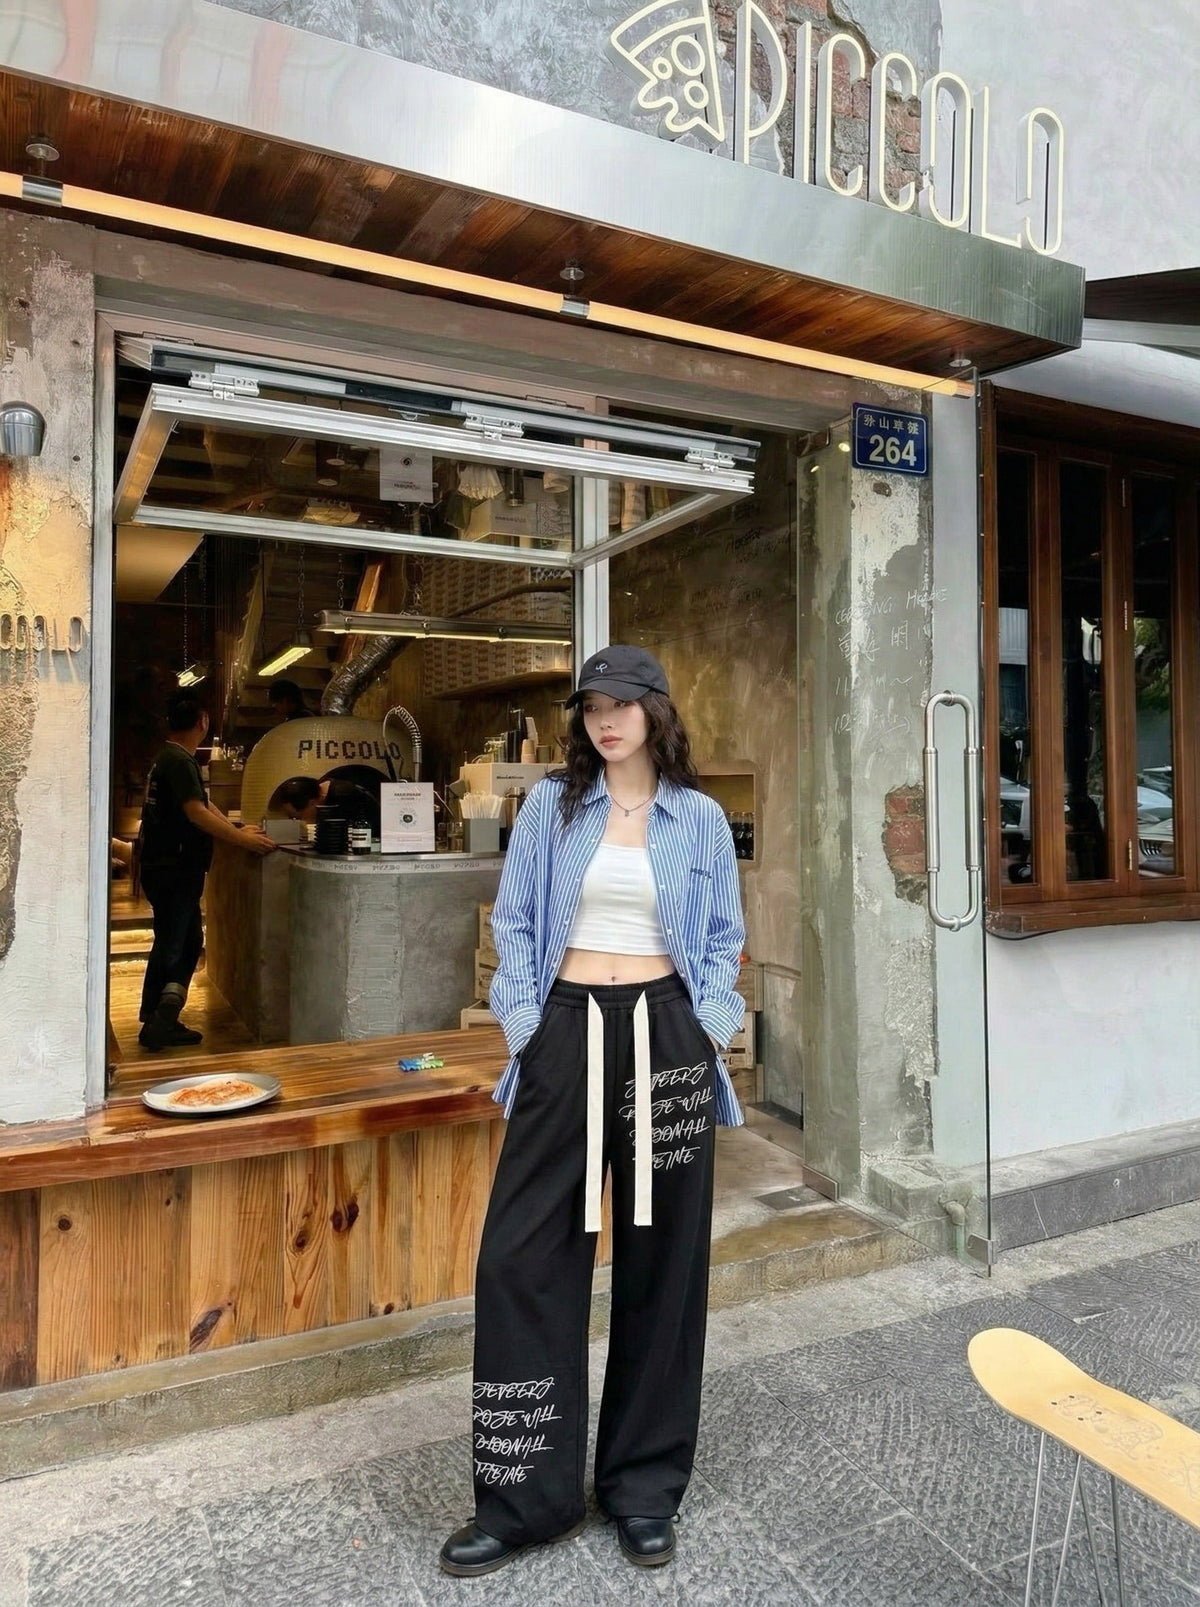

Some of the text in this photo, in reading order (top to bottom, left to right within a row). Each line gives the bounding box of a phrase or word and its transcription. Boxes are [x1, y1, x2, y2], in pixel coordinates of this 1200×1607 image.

[734, 0, 1064, 256] PICCOLO
[869, 434, 917, 467] 264
[297, 739, 402, 760] PICCOLO
